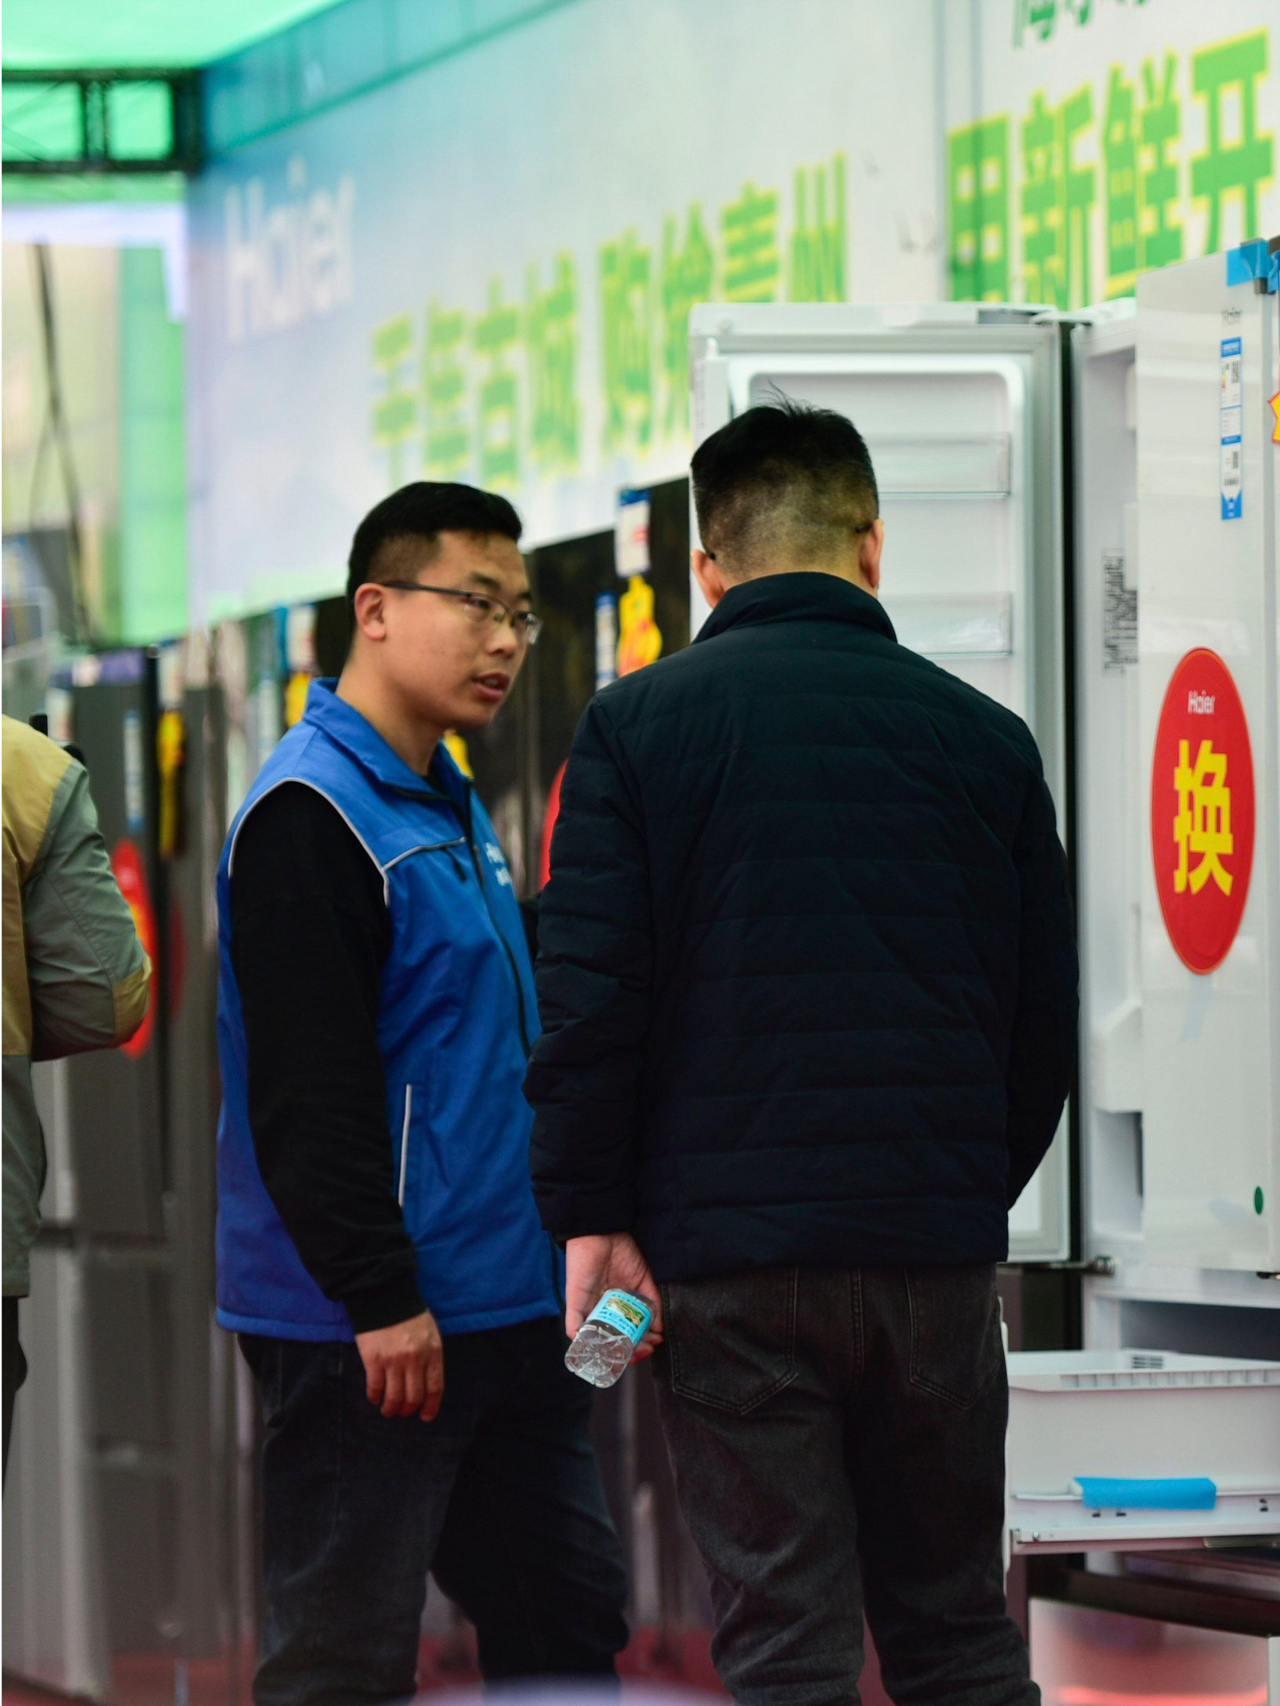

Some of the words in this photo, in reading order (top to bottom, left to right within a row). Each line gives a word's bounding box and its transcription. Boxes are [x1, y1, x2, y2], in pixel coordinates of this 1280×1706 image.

[225, 152, 357, 345] Haier
[1188, 690, 1215, 714] Haier
[1173, 739, 1234, 896] 换
